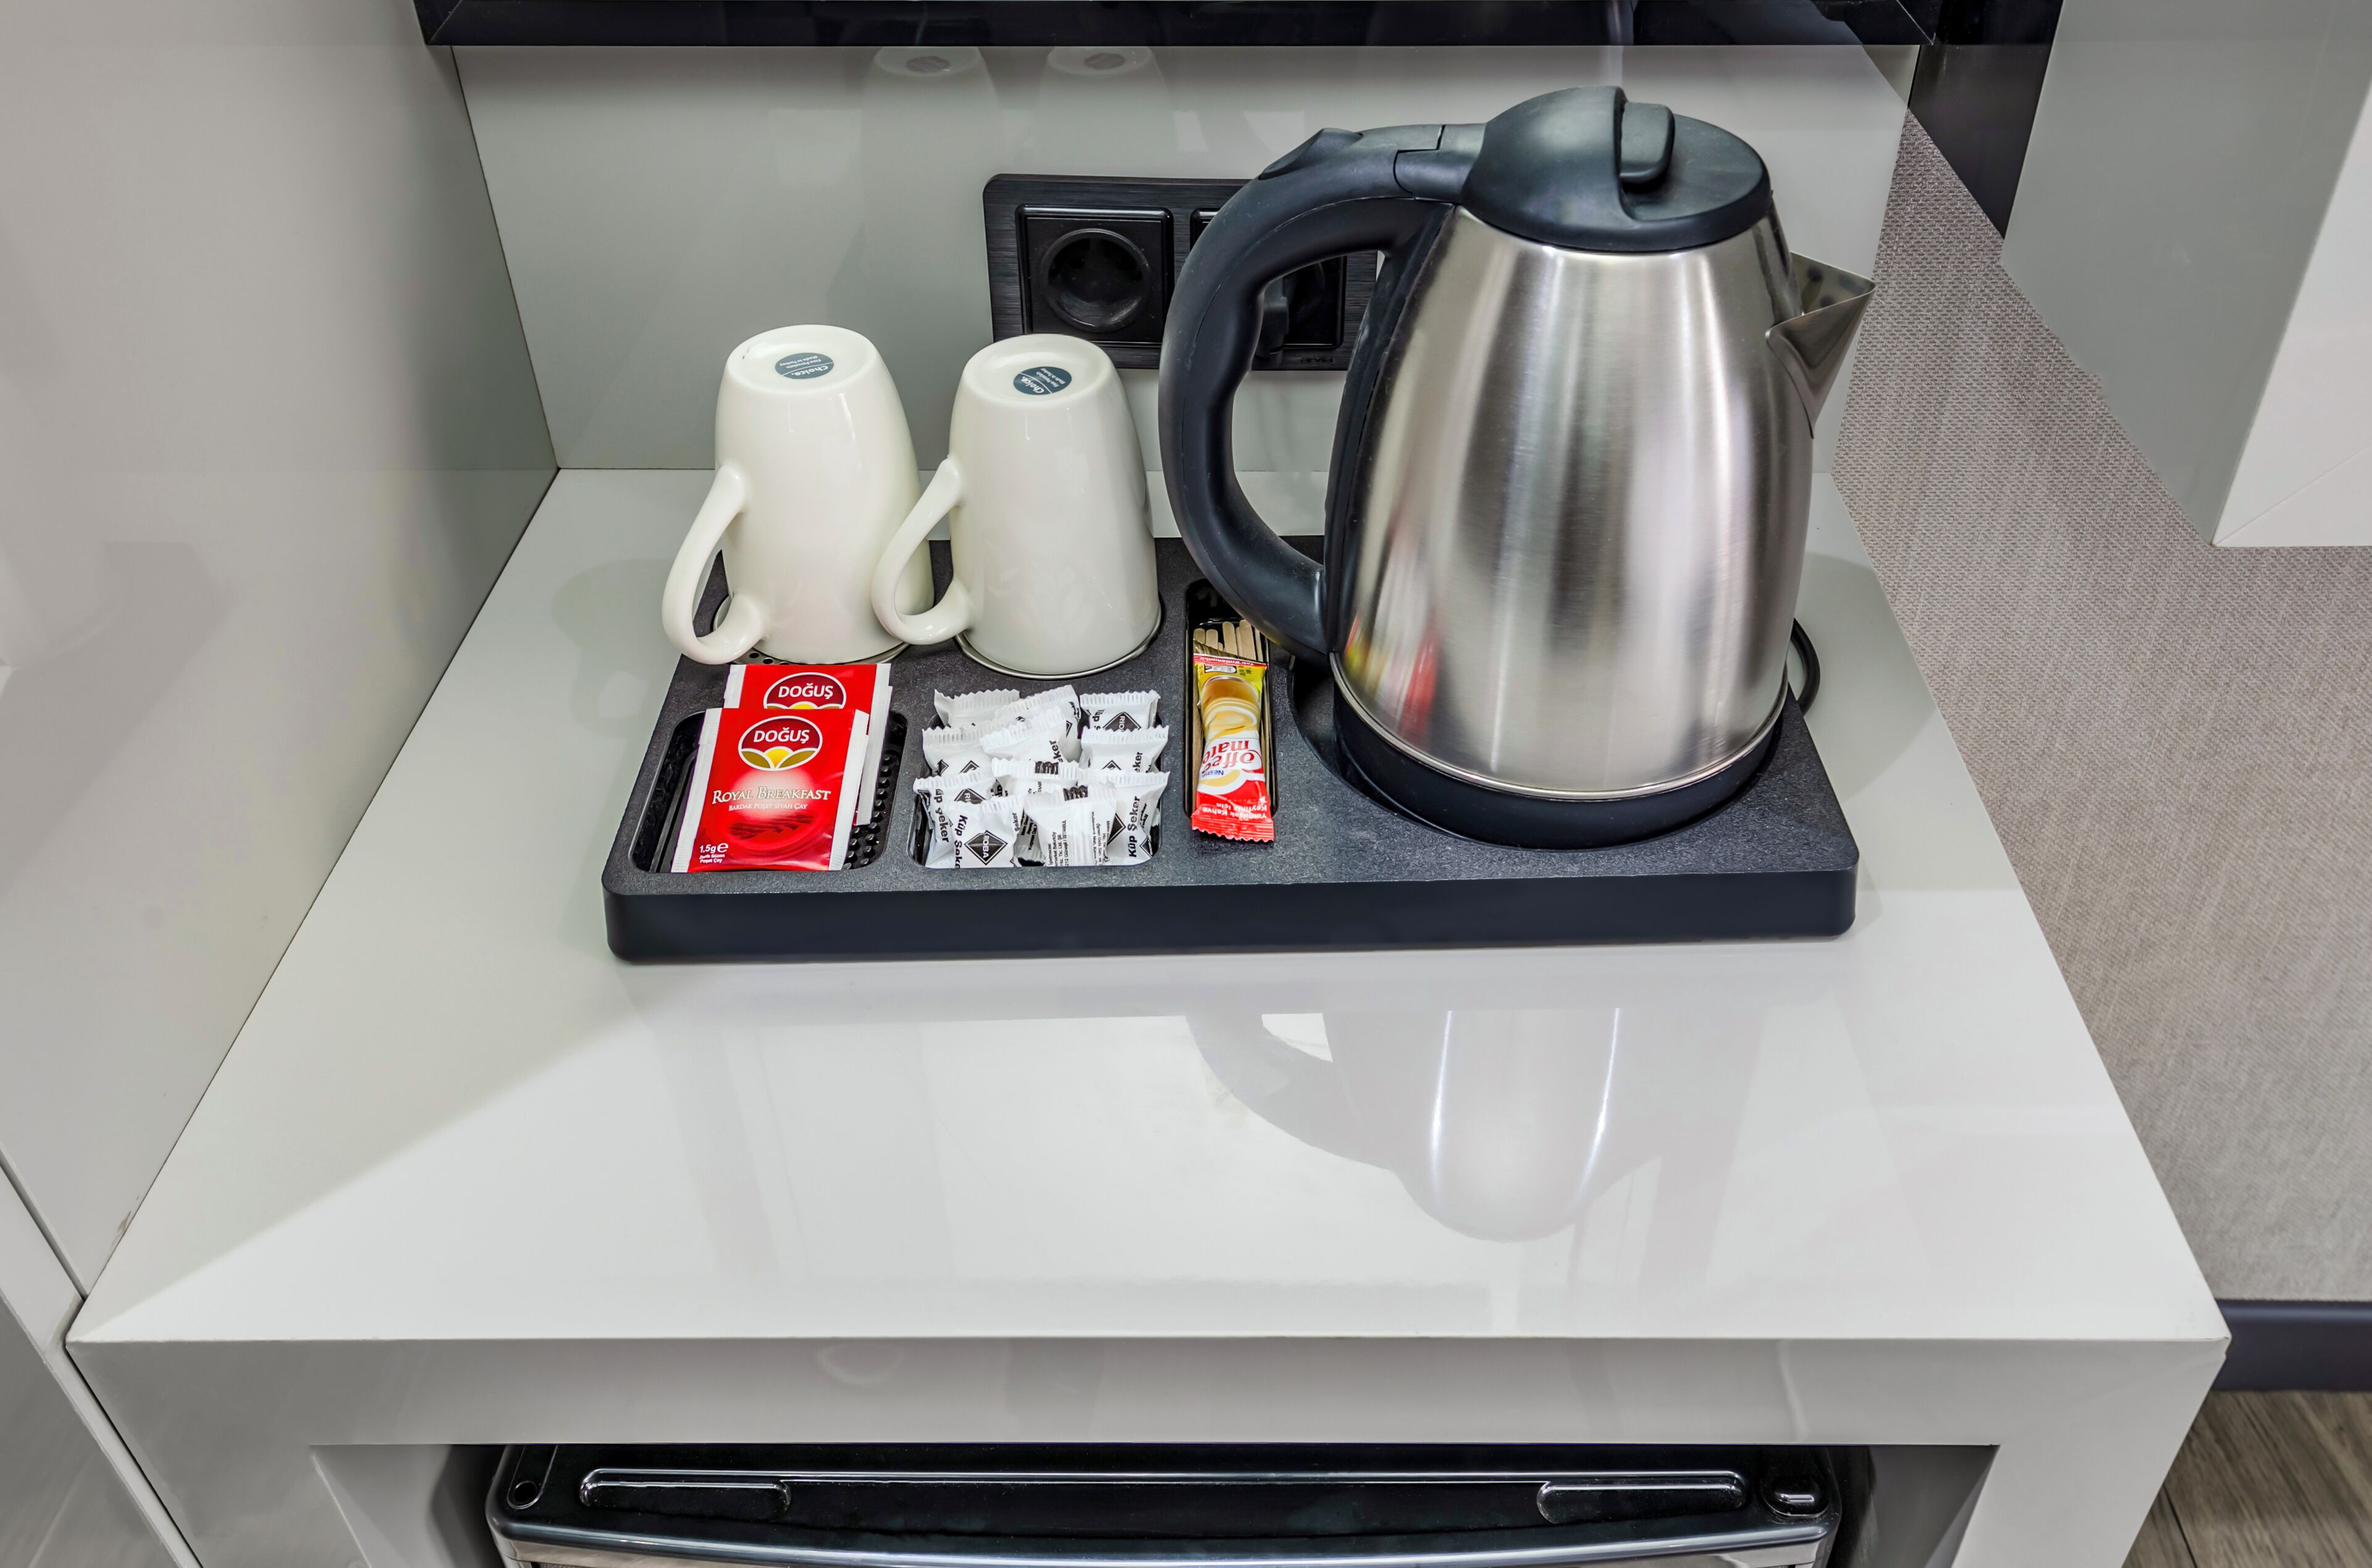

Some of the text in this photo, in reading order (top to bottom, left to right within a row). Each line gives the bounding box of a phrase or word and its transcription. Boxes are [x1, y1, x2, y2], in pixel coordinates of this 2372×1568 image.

[778, 682, 834, 700] DOĞUŞ
[753, 727, 810, 744] DOĞUŞ
[712, 786, 831, 804] ROYAL BREAKFAST
[1202, 807, 1227, 815] Kahve
[954, 815, 968, 836] Küp
[1127, 796, 1140, 858] Küp Şeker
